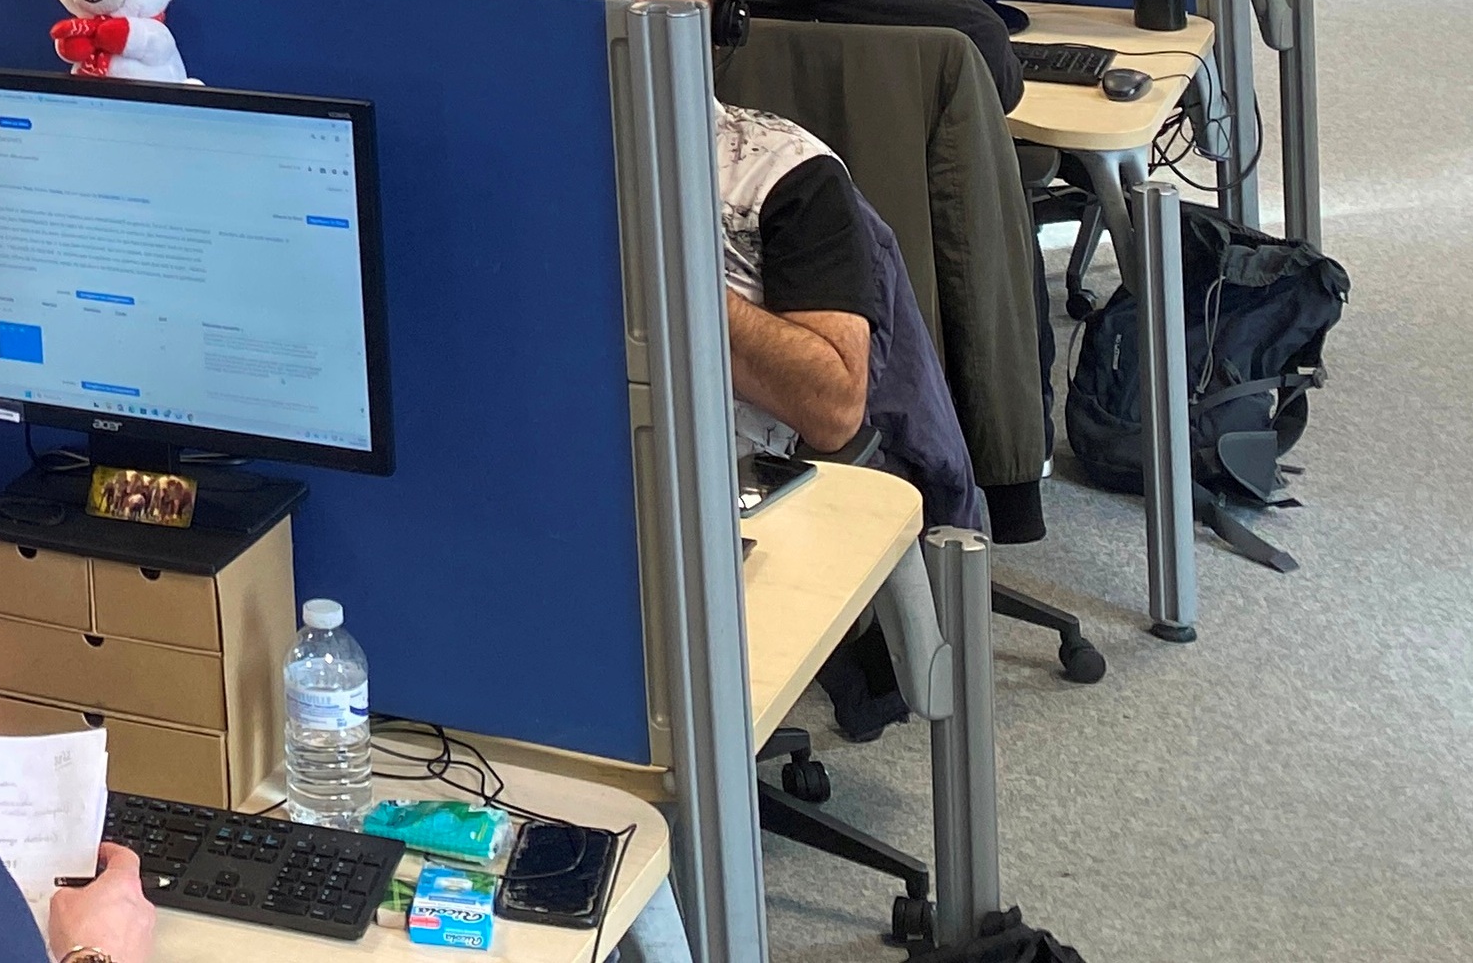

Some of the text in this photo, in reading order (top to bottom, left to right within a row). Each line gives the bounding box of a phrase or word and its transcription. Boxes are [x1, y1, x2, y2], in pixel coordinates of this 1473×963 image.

[92, 419, 123, 432] acer
[418, 907, 483, 921] Ricola
[445, 933, 483, 946] Ricola
